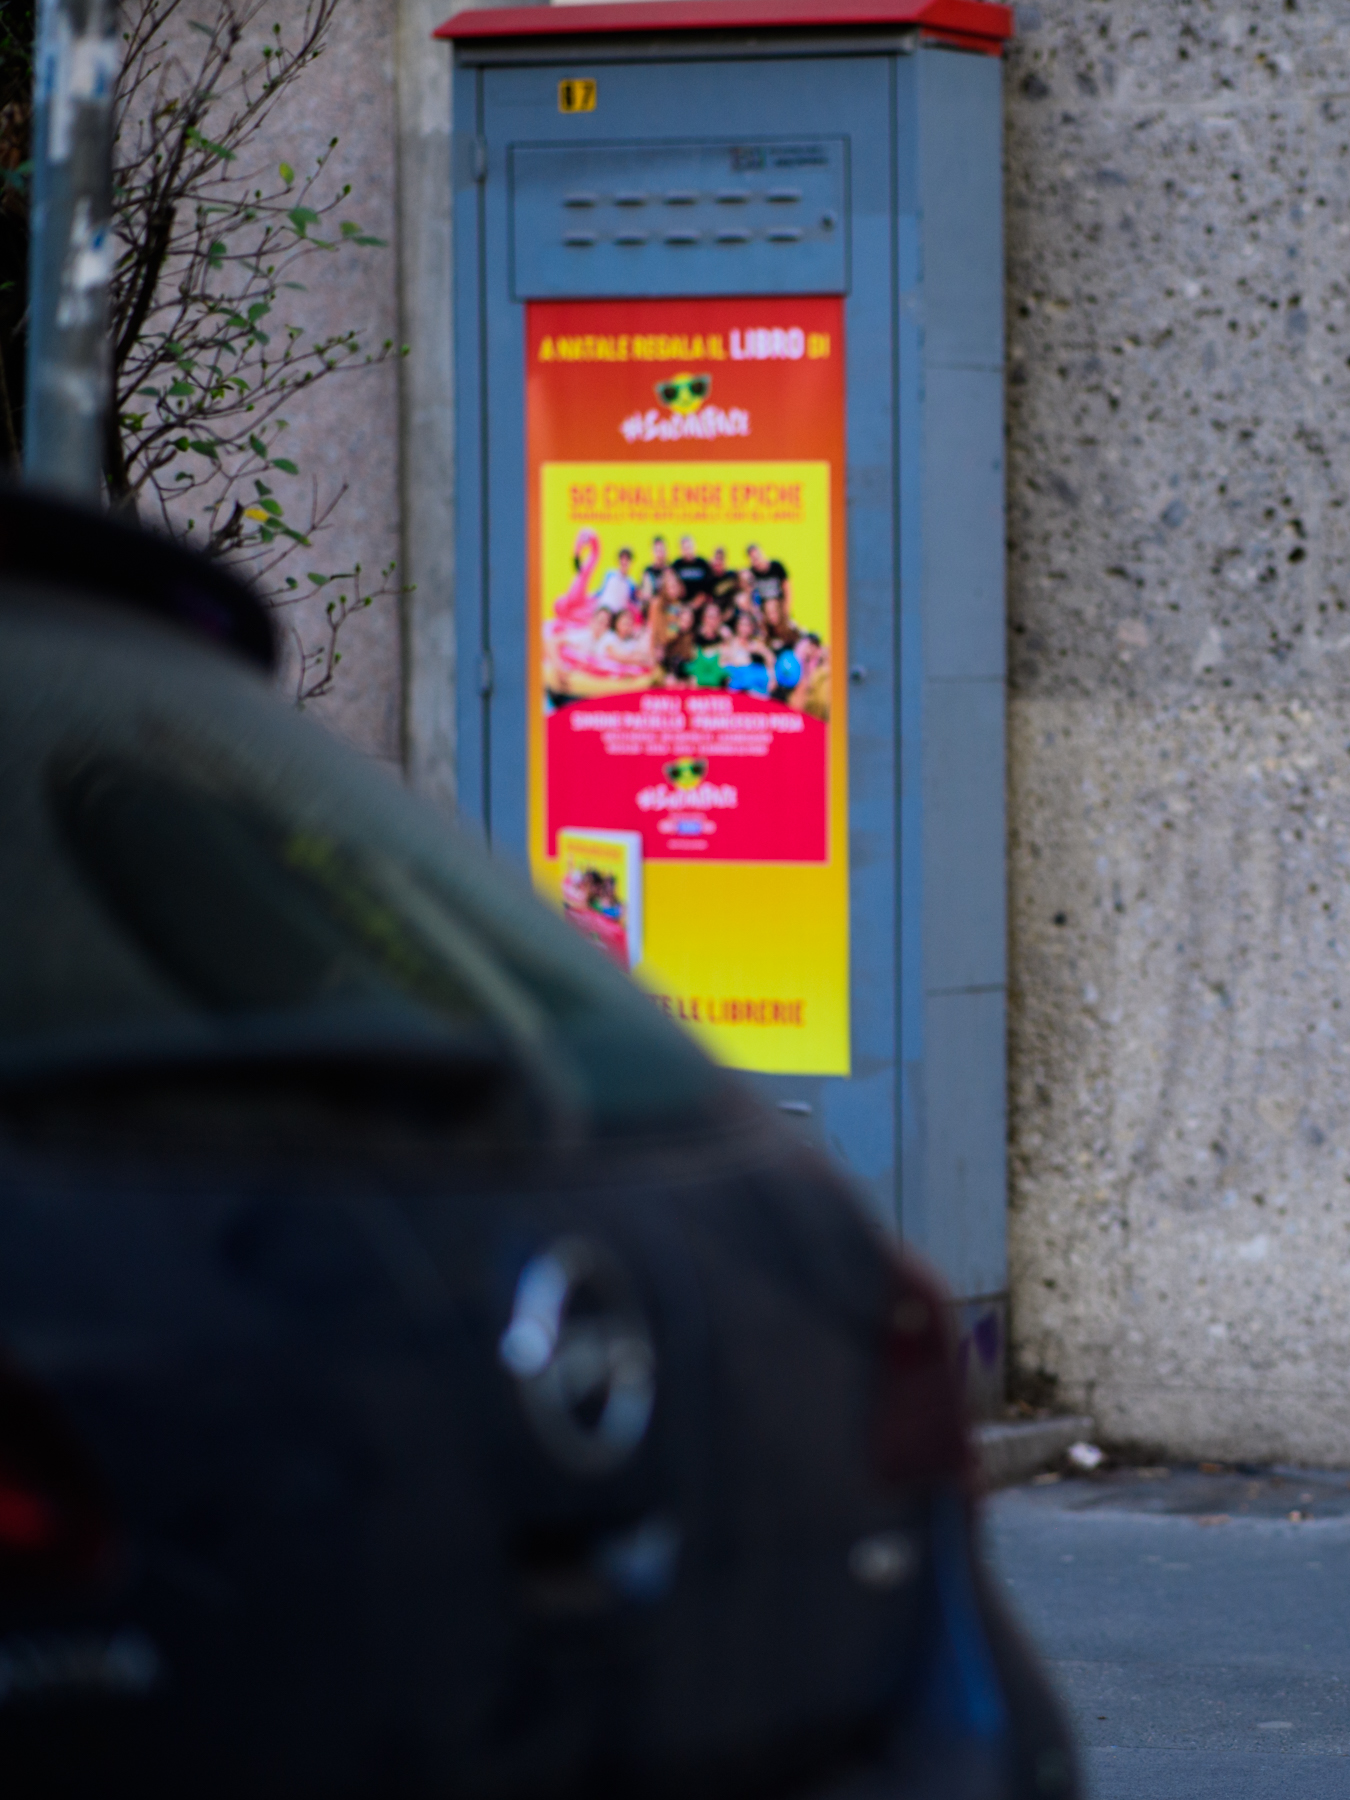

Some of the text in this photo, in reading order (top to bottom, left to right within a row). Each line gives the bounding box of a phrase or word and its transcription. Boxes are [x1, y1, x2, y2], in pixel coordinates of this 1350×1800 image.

[557, 335, 628, 361] NATALE
[633, 334, 704, 361] REGALA
[731, 328, 804, 359] LIBRO
[808, 334, 829, 359] DI
[602, 483, 724, 508] CHALLENGE
[730, 483, 804, 508] EPICHE
[706, 998, 806, 1026] LIBRERIE
